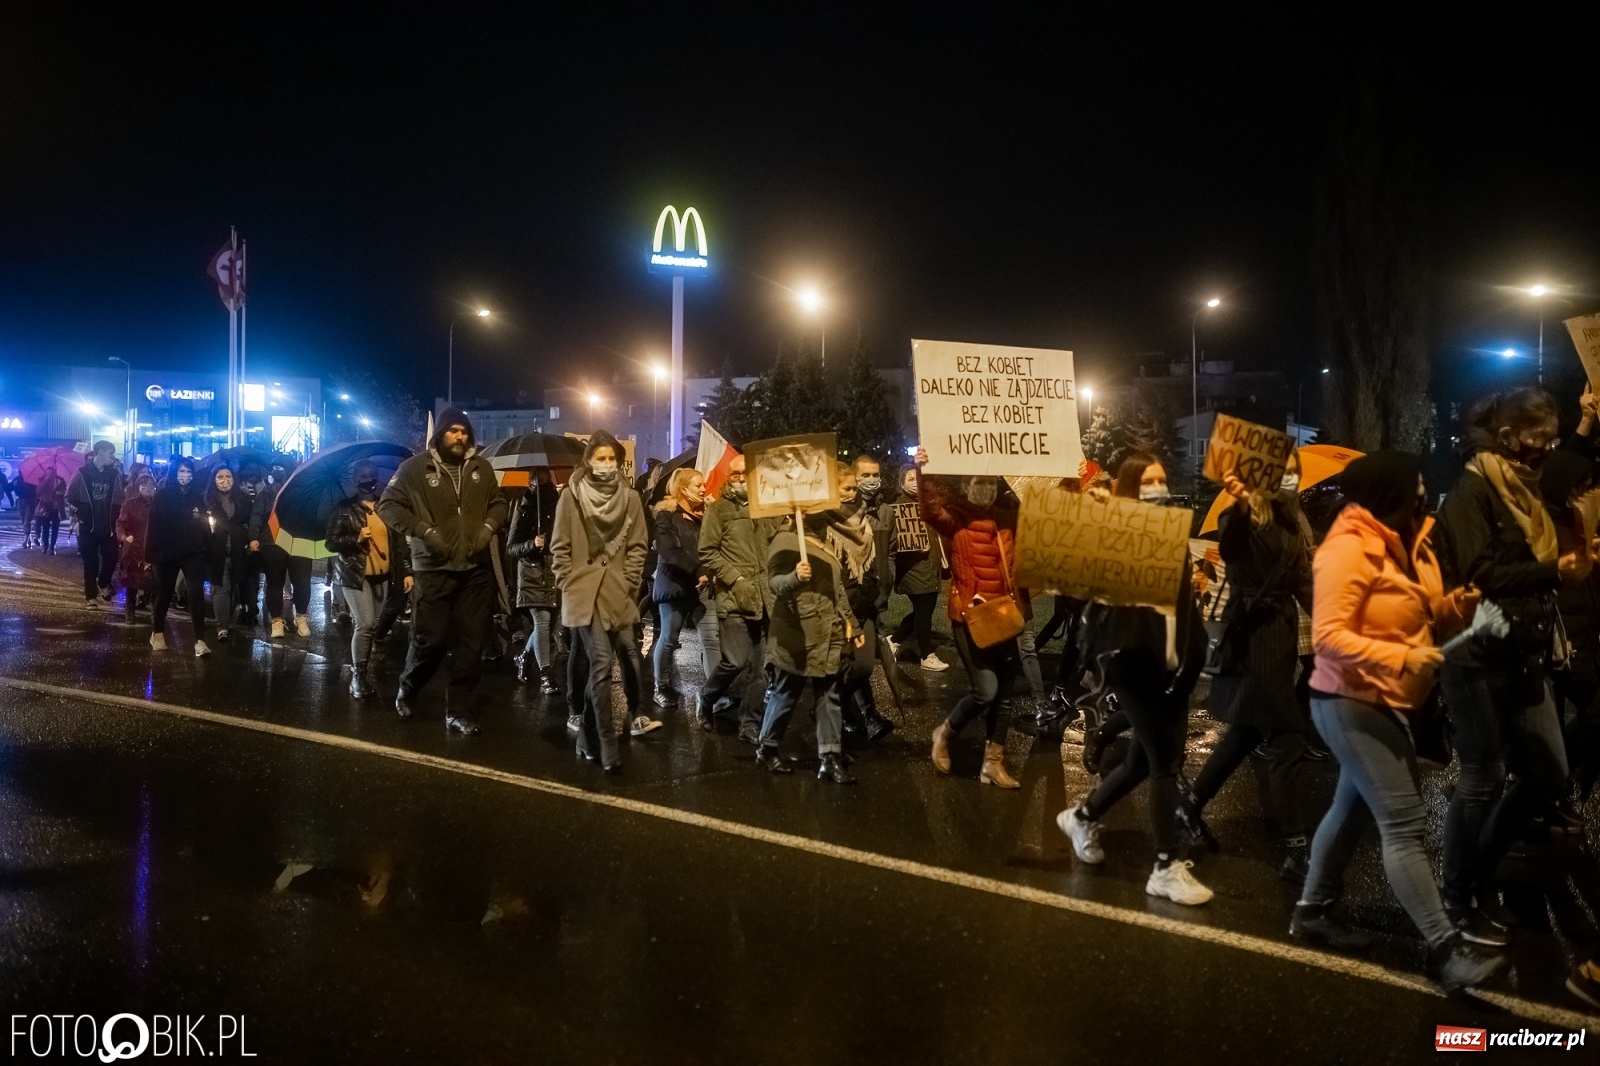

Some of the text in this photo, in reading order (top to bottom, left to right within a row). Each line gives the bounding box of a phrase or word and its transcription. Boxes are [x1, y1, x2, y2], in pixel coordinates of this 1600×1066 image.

[956, 356, 1034, 376] BEZ KOBIET
[171, 389, 215, 400] ŁAZIENKI
[921, 378, 1075, 405] DALEKO NIE ZAJDZIECIE
[962, 405, 1044, 425] BEZ KOBIET
[949, 432, 1050, 455] WYGINIECIE
[1234, 453, 1286, 493] KRAJ
[891, 503, 921, 518] ERTE
[1025, 485, 1083, 521] MOIM
[898, 519, 926, 534] LITE
